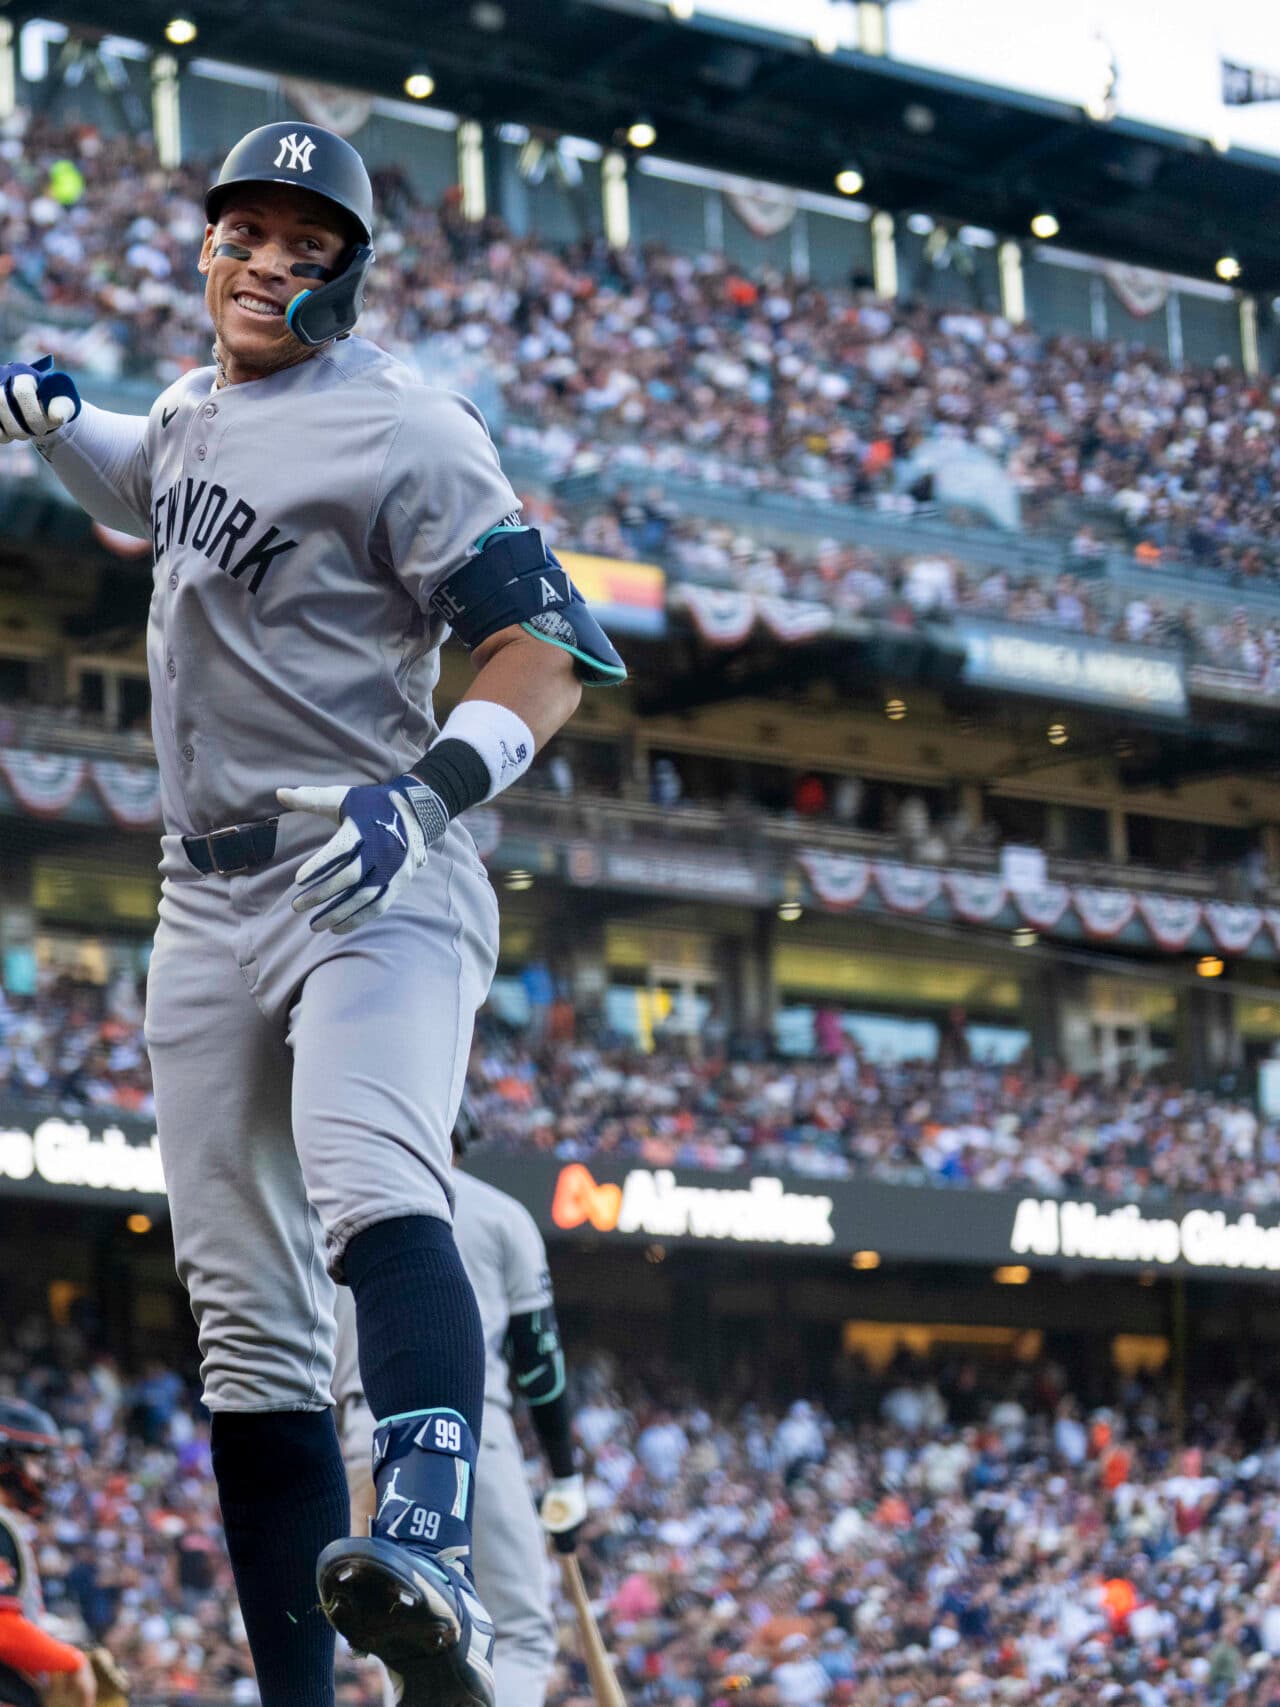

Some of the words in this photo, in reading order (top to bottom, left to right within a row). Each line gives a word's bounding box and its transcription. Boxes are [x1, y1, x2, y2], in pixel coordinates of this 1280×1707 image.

[178, 478, 299, 595] YORK
[1180, 1209, 1280, 1270] Globa
[435, 1418, 461, 1451] 99
[410, 1508, 441, 1540] 99
